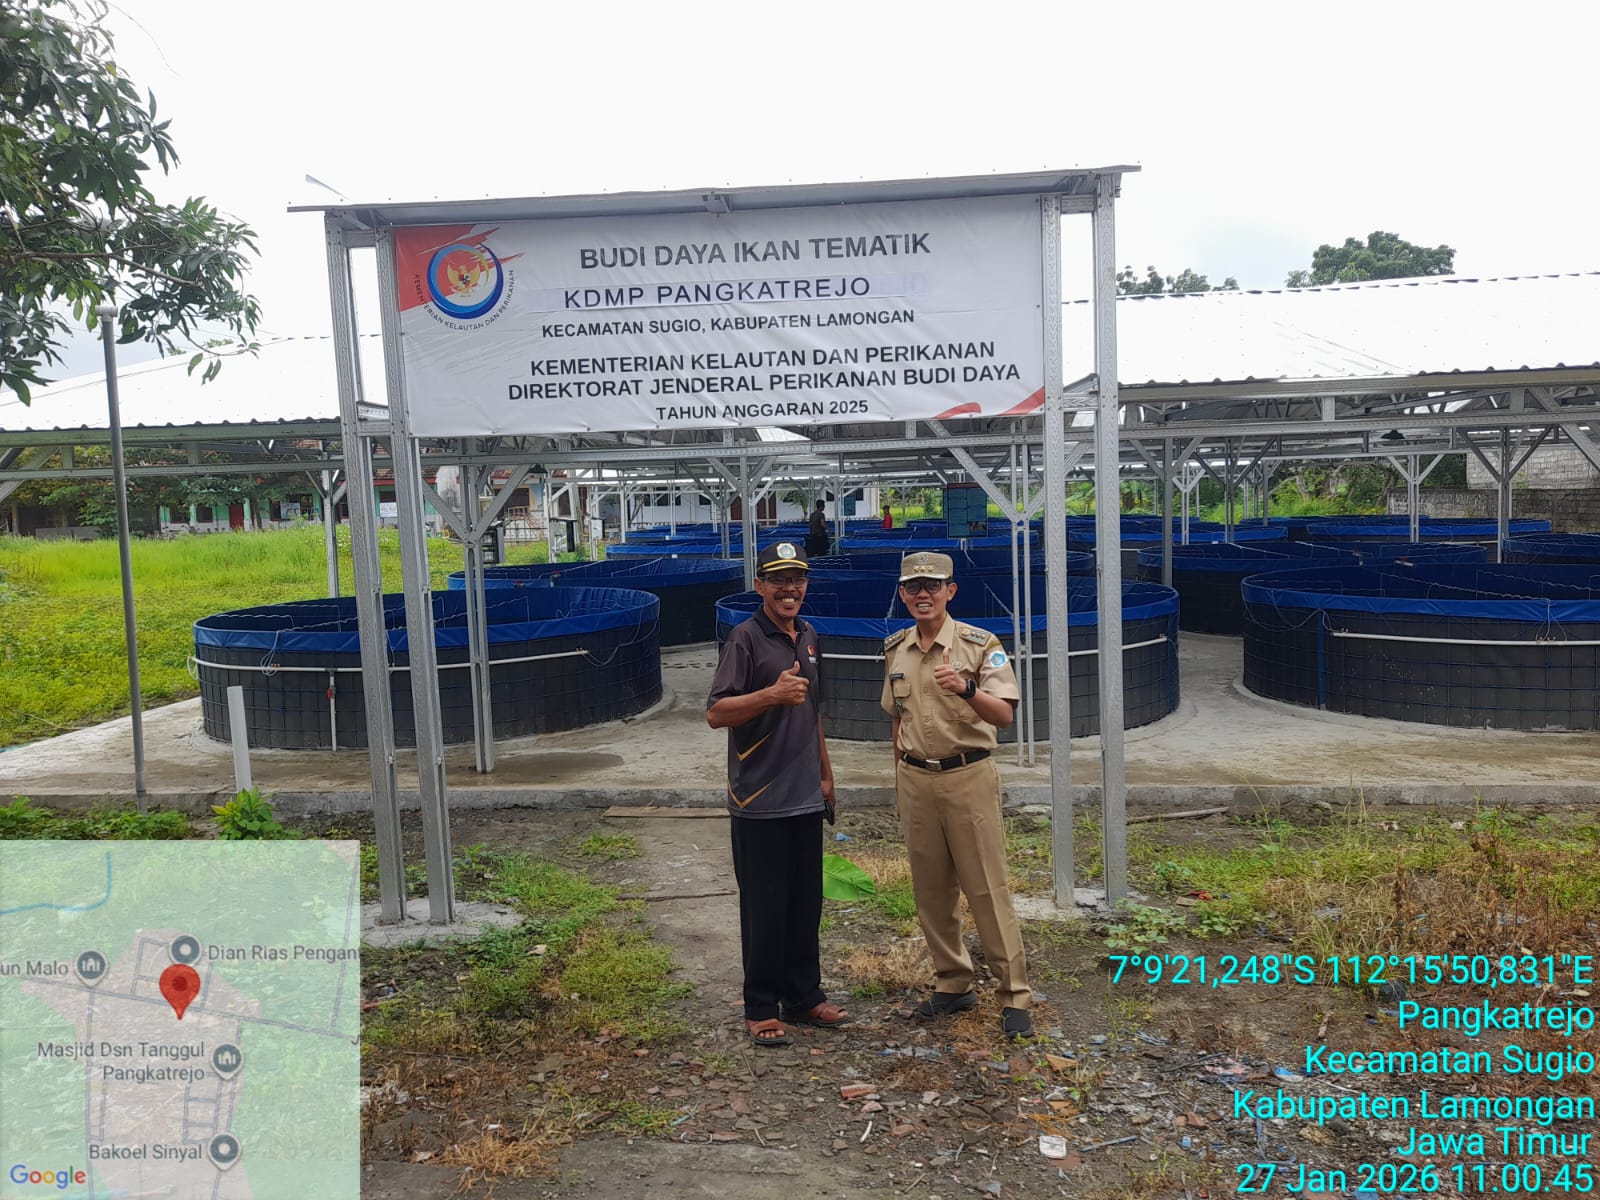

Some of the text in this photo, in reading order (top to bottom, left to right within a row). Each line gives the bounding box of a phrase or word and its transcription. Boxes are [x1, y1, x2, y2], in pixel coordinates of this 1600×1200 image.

[581, 232, 931, 269] BUDI DAYA IKAN TEMATIK
[444, 322, 485, 331] KELAUTAN
[484, 314, 500, 326] DAN
[499, 269, 515, 315] PERIKANAN
[564, 277, 870, 309] KDMP PANGKATREJO
[542, 309, 914, 338] KECAMATAN SUGIO, KABUPATEN LAMONGAN
[530, 341, 994, 377] KEMENTERIAN KELAUTAN DAN PERIKANAN
[508, 363, 1020, 400] DIREKTORAT JENDERAL PERIKANAN BUDI DAYA
[656, 399, 869, 420] TAHUN ANGGARAN 2025
